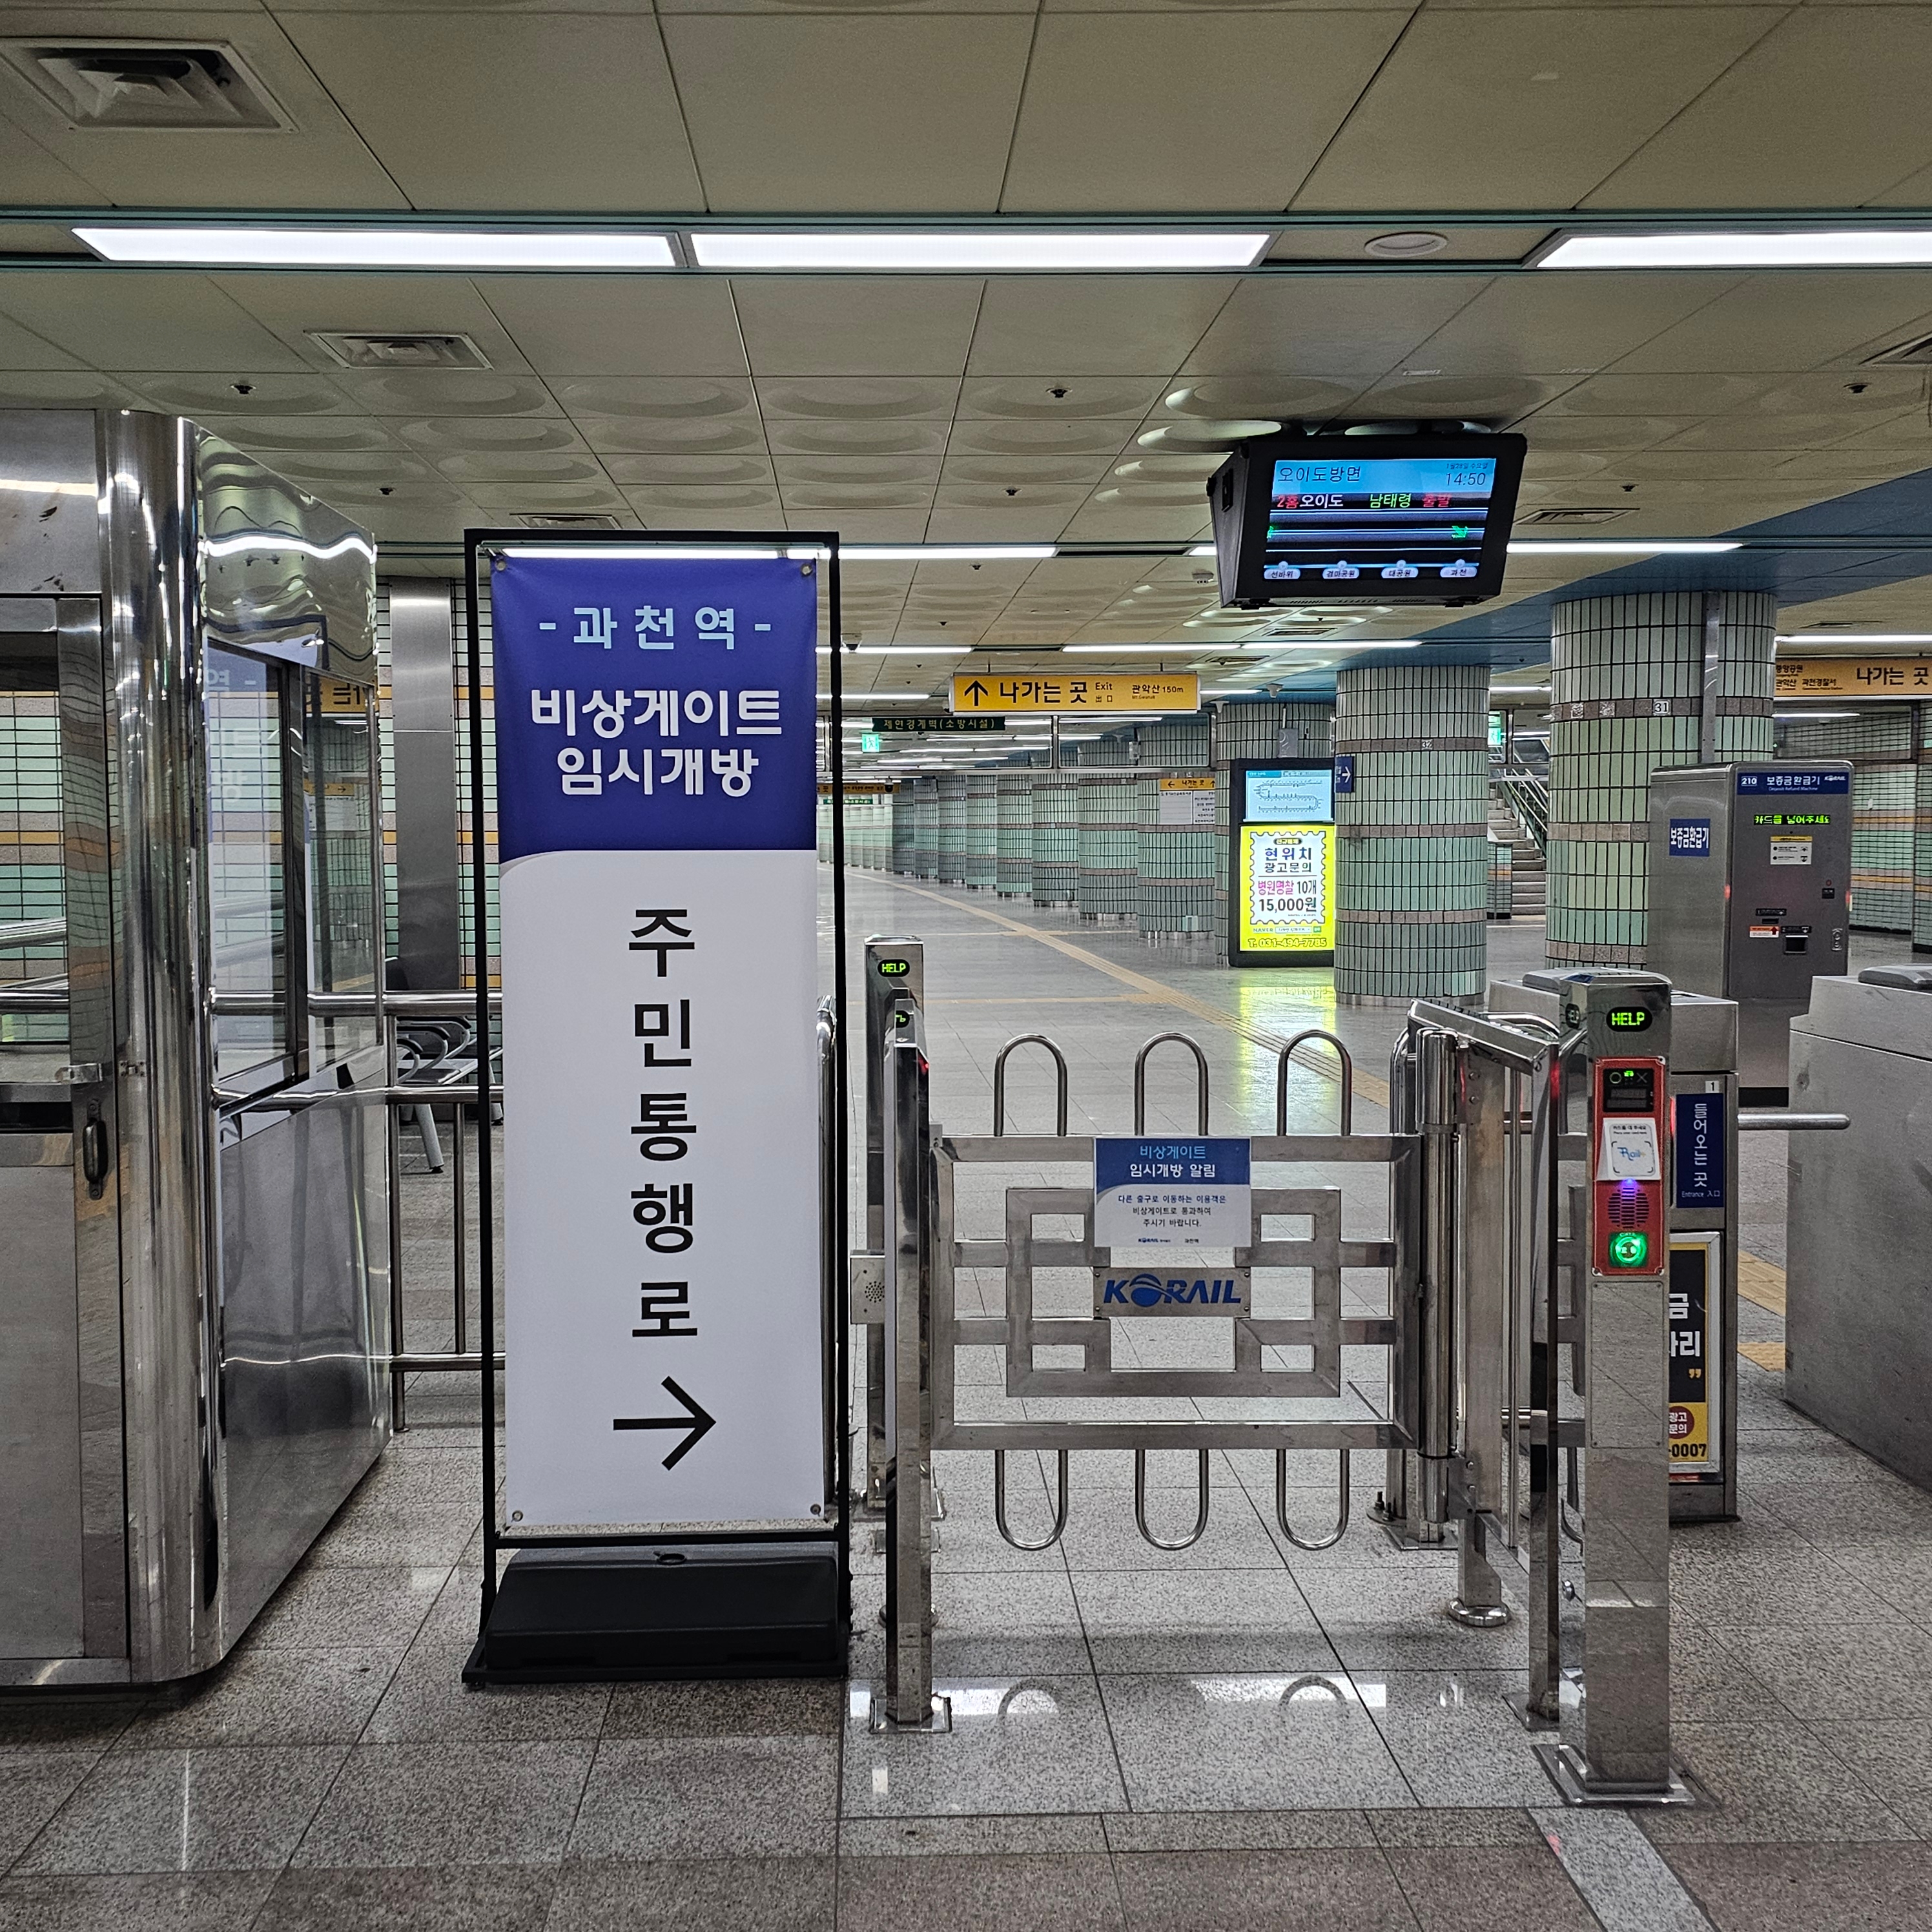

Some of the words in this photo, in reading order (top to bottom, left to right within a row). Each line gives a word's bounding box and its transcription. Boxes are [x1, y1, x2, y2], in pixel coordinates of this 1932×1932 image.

[1278, 466, 1361, 483] 오이도방면
[1446, 472, 1486, 486] 14:50
[1299, 493, 1344, 509] 오이도
[1370, 493, 1412, 508] 남태령
[1450, 568, 1467, 577] 과천
[1802, 679, 1836, 687] 과천경찰서
[1856, 667, 1904, 686] 나가는
[1913, 667, 1929, 686] 곳
[999, 681, 1062, 704] 나가는
[1069, 681, 1089, 704] 곳
[1095, 682, 1113, 691] Exit
[1132, 684, 1160, 694] 관악산
[531, 689, 782, 739] 비상게이트
[1654, 703, 1668, 713] 31
[557, 747, 759, 797] 임시개방
[1754, 815, 1782, 825] 카드를
[1786, 815, 1831, 825] 넣어주세요
[1670, 827, 1709, 849] 보증금환급기
[1264, 862, 1311, 873] 광고문의
[1258, 880, 1294, 896] 병원명찰
[1297, 879, 1317, 895] 10개
[1259, 897, 1317, 914] 15,000원
[1259, 938, 1327, 948] 031-494-7785
[881, 963, 907, 973] HELP
[1611, 1011, 1645, 1026] HELP
[1710, 1082, 1715, 1091] 1
[627, 908, 698, 1338] 주민통행로
[1693, 1103, 1708, 1166] 들어오는
[1140, 1146, 1206, 1160] 비상게이트
[1129, 1164, 1183, 1178] 임시개방
[1189, 1164, 1216, 1178] 알림
[1693, 1172, 1708, 1187] 곳
[1118, 1195, 1132, 1204] 다른
[1162, 1195, 1192, 1204] 이동하는
[1196, 1195, 1226, 1204] 이용객은
[1133, 1206, 1177, 1215] 비상게이트로
[1181, 1206, 1211, 1215] 통과하여
[1143, 1218, 1165, 1227] 주시기
[1169, 1218, 1202, 1228] 바랍니다.
[1103, 1273, 1242, 1308] KORAIL
